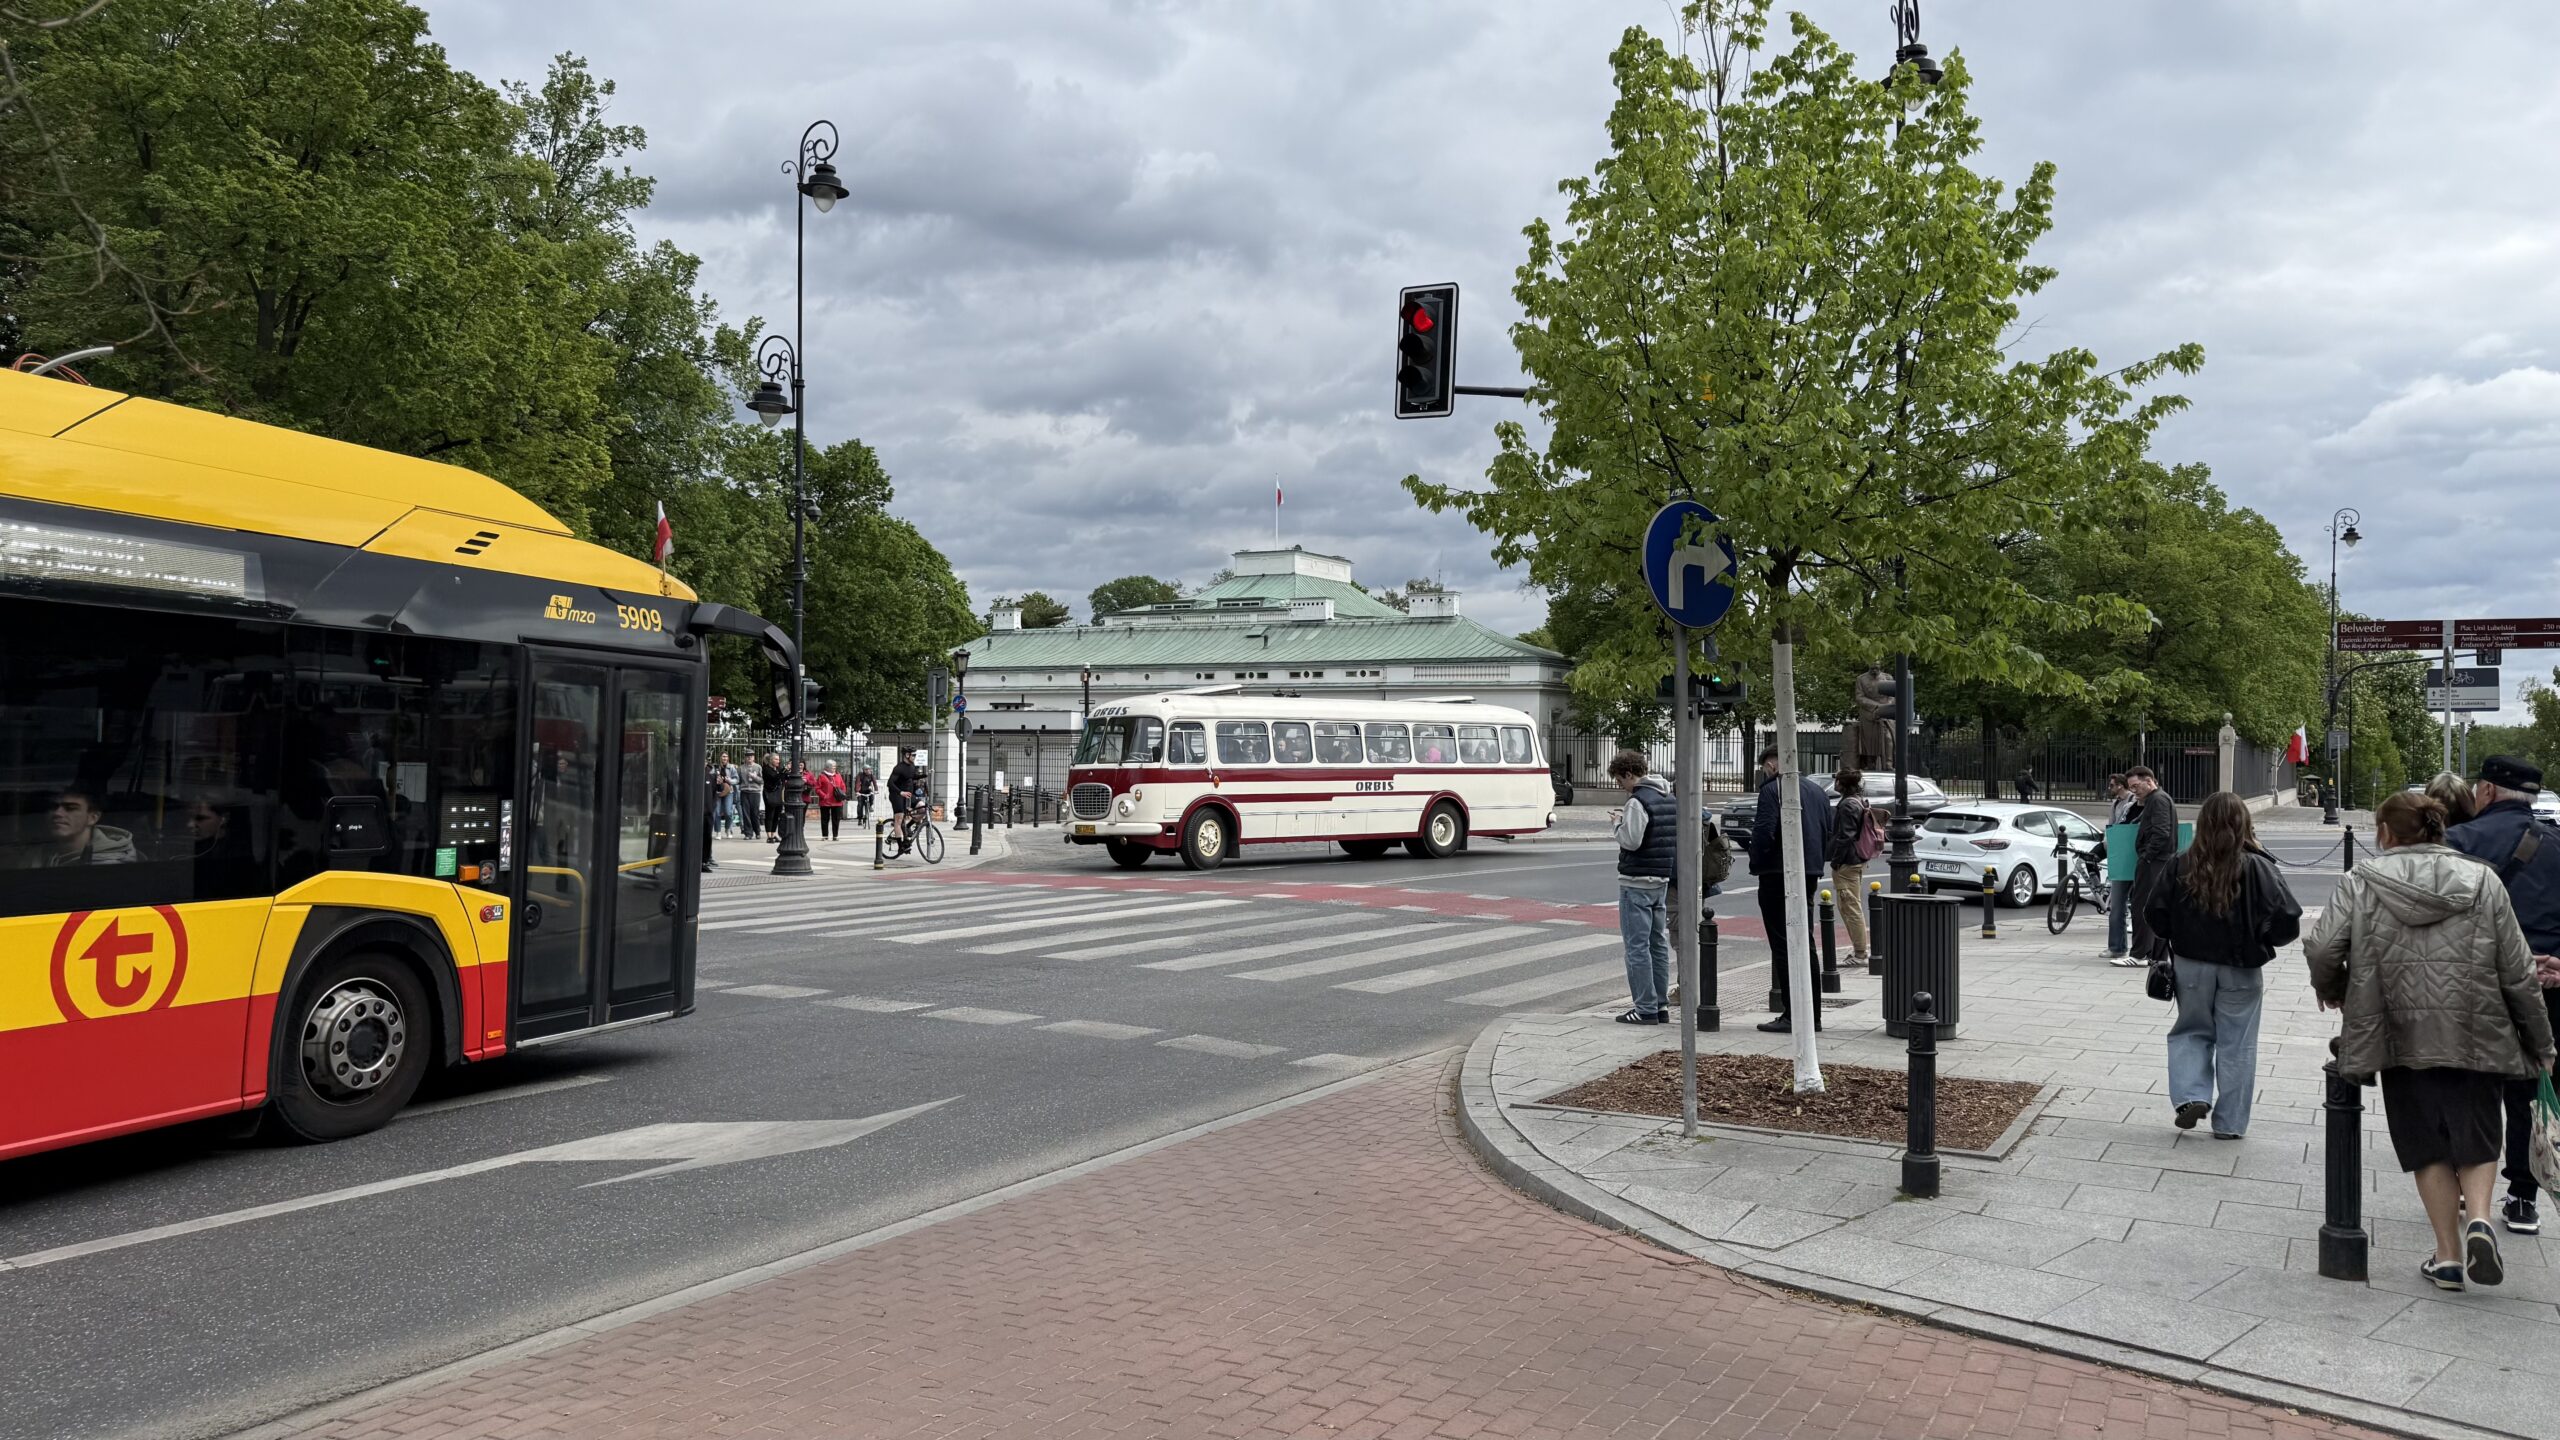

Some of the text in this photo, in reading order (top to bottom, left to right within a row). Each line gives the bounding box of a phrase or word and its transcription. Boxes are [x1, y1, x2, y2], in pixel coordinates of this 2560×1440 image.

[568, 609, 596, 624] mza
[617, 604, 662, 632] 5909
[2340, 622, 2386, 633] Belweder
[1093, 706, 1130, 718] ORBIS
[1355, 781, 1394, 792] ORBIS
